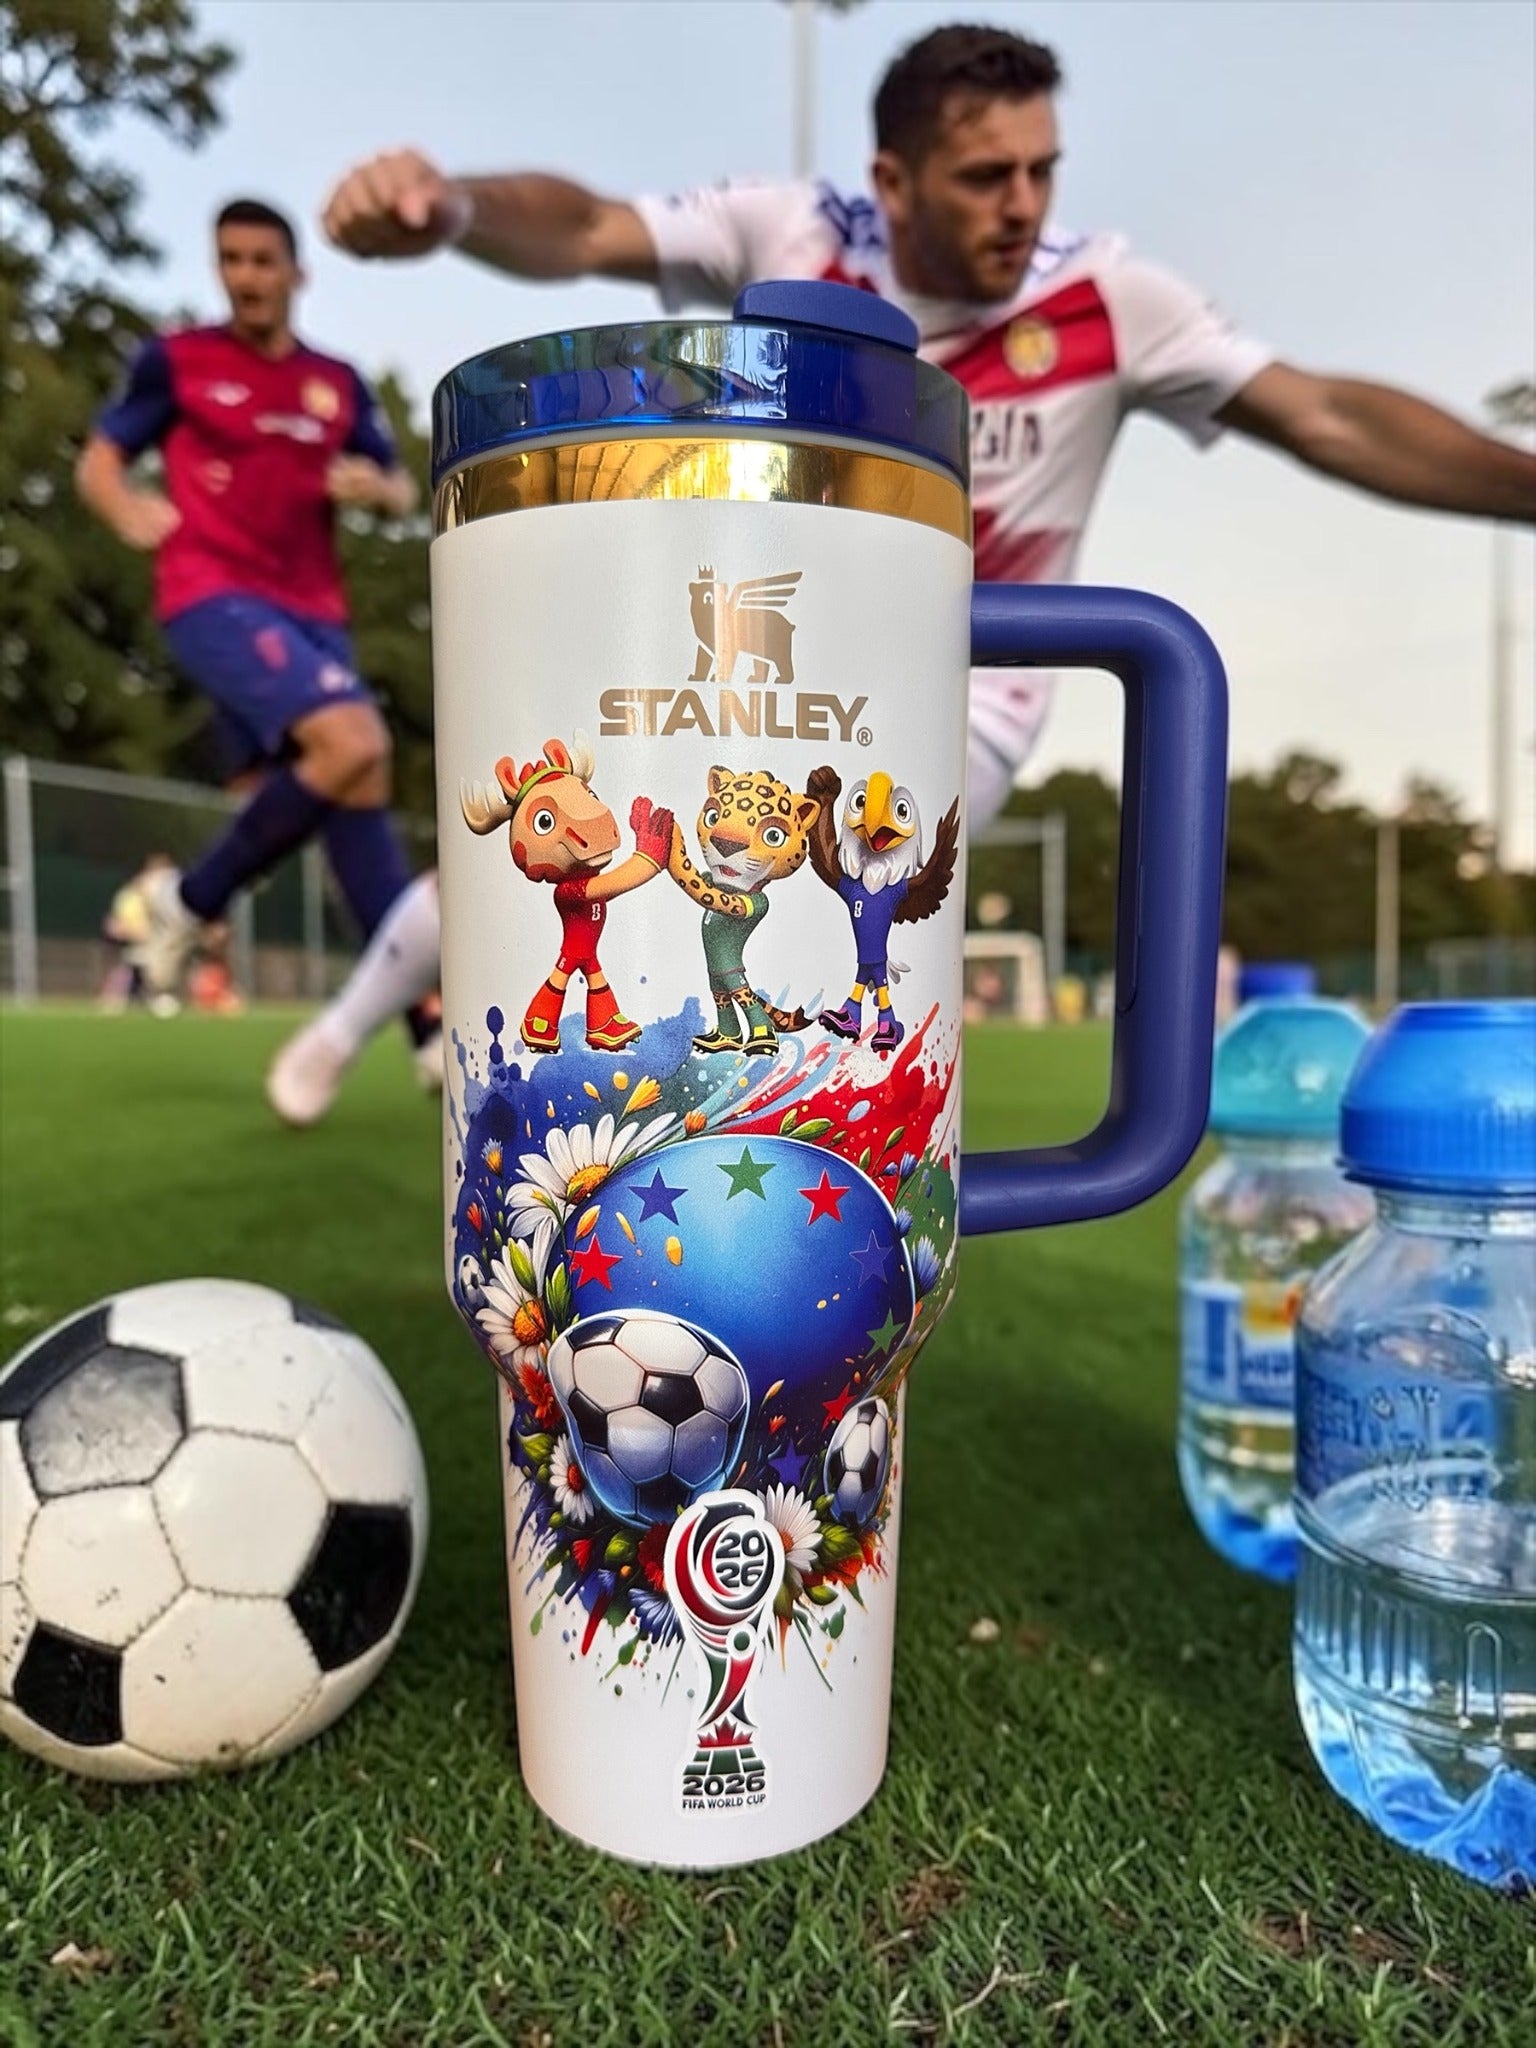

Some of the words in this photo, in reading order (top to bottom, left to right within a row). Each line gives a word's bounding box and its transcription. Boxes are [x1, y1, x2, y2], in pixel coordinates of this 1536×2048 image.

[715, 1529, 766, 1559] 20
[715, 1559, 765, 1588] 26
[682, 1770, 766, 1796] 2026
[682, 1798, 706, 1809] FIFA
[707, 1796, 744, 1809] WORLD
[746, 1793, 766, 1805] CUP
